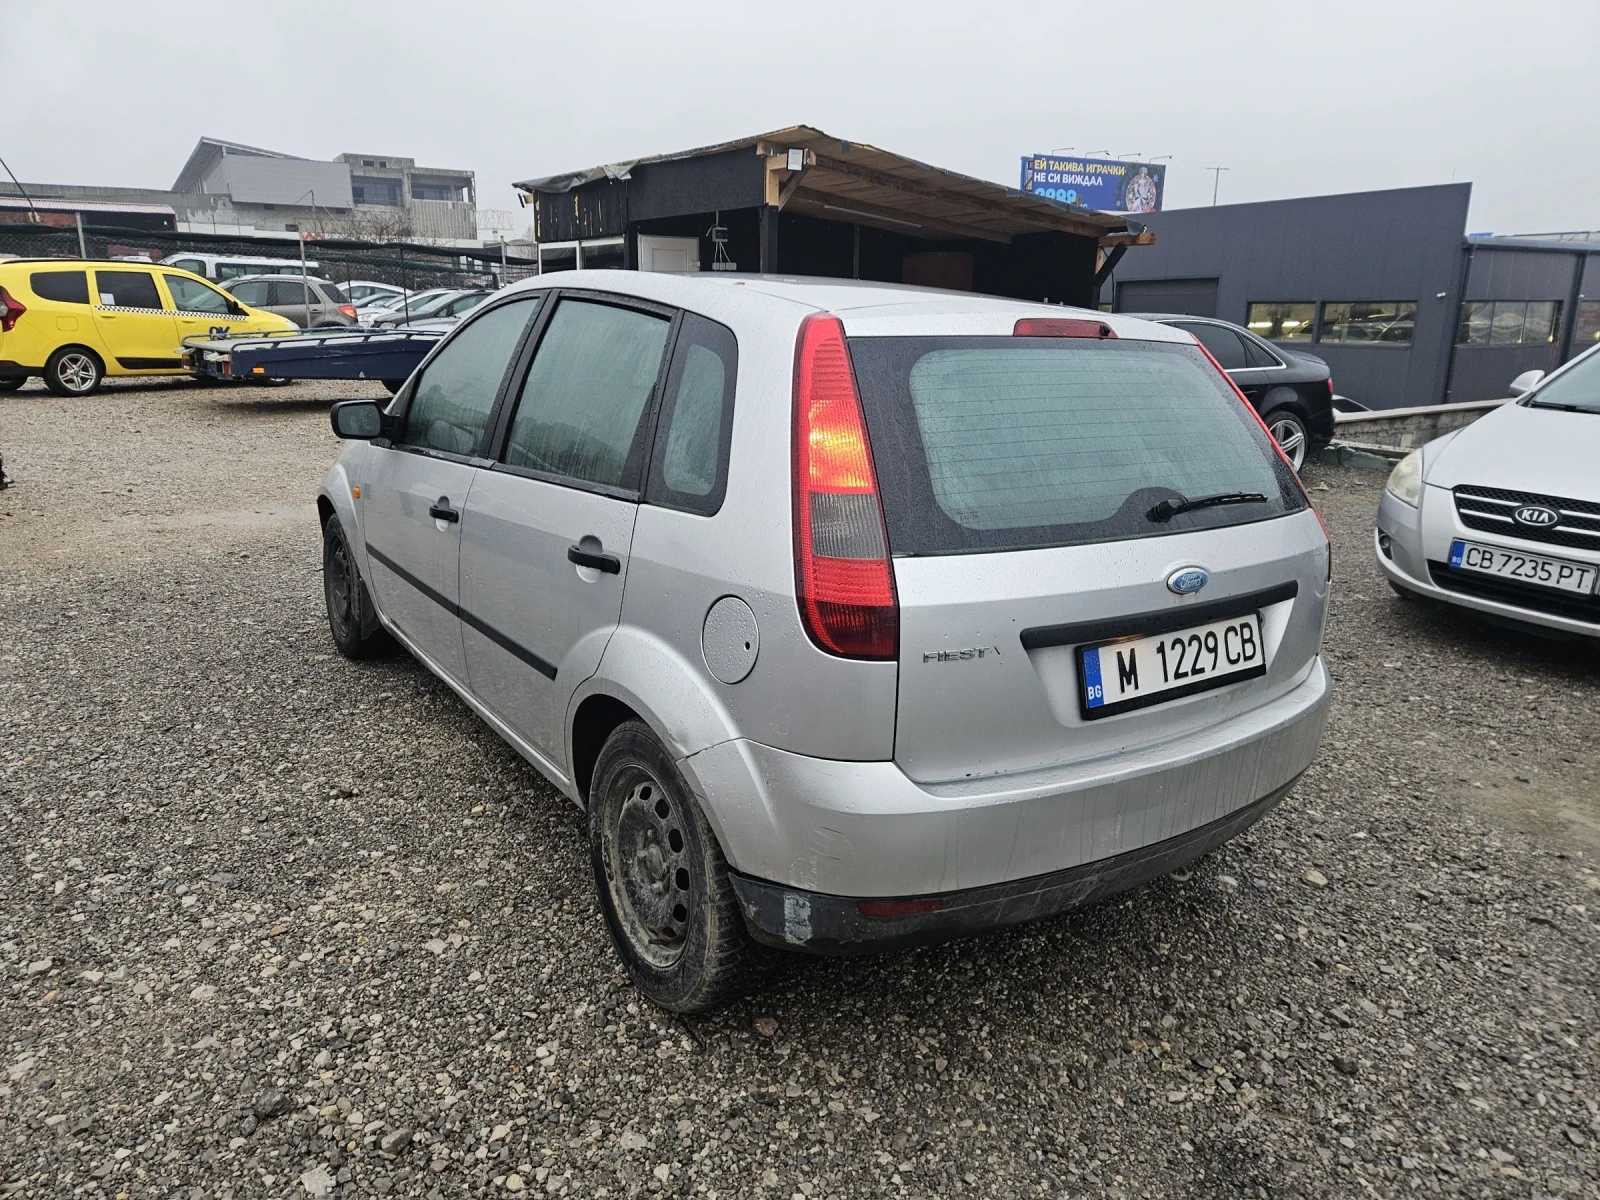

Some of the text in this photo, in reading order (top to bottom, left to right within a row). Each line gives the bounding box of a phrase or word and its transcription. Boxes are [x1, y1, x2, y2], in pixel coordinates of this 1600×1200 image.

[1034, 158, 1125, 176] ЕЙ ТАКИВА ИГРАЧКИ
[1033, 172, 1103, 187] НЕ СИ ВИЖДАЛ
[1520, 509, 1549, 523] KIA
[1451, 556, 1462, 564] BG
[1466, 547, 1590, 589] CB 7235 PT
[1180, 573, 1203, 588] Ford
[923, 646, 1001, 664] FIESTA
[1116, 622, 1257, 694] M 1229 CB
[1087, 685, 1102, 700] BG
